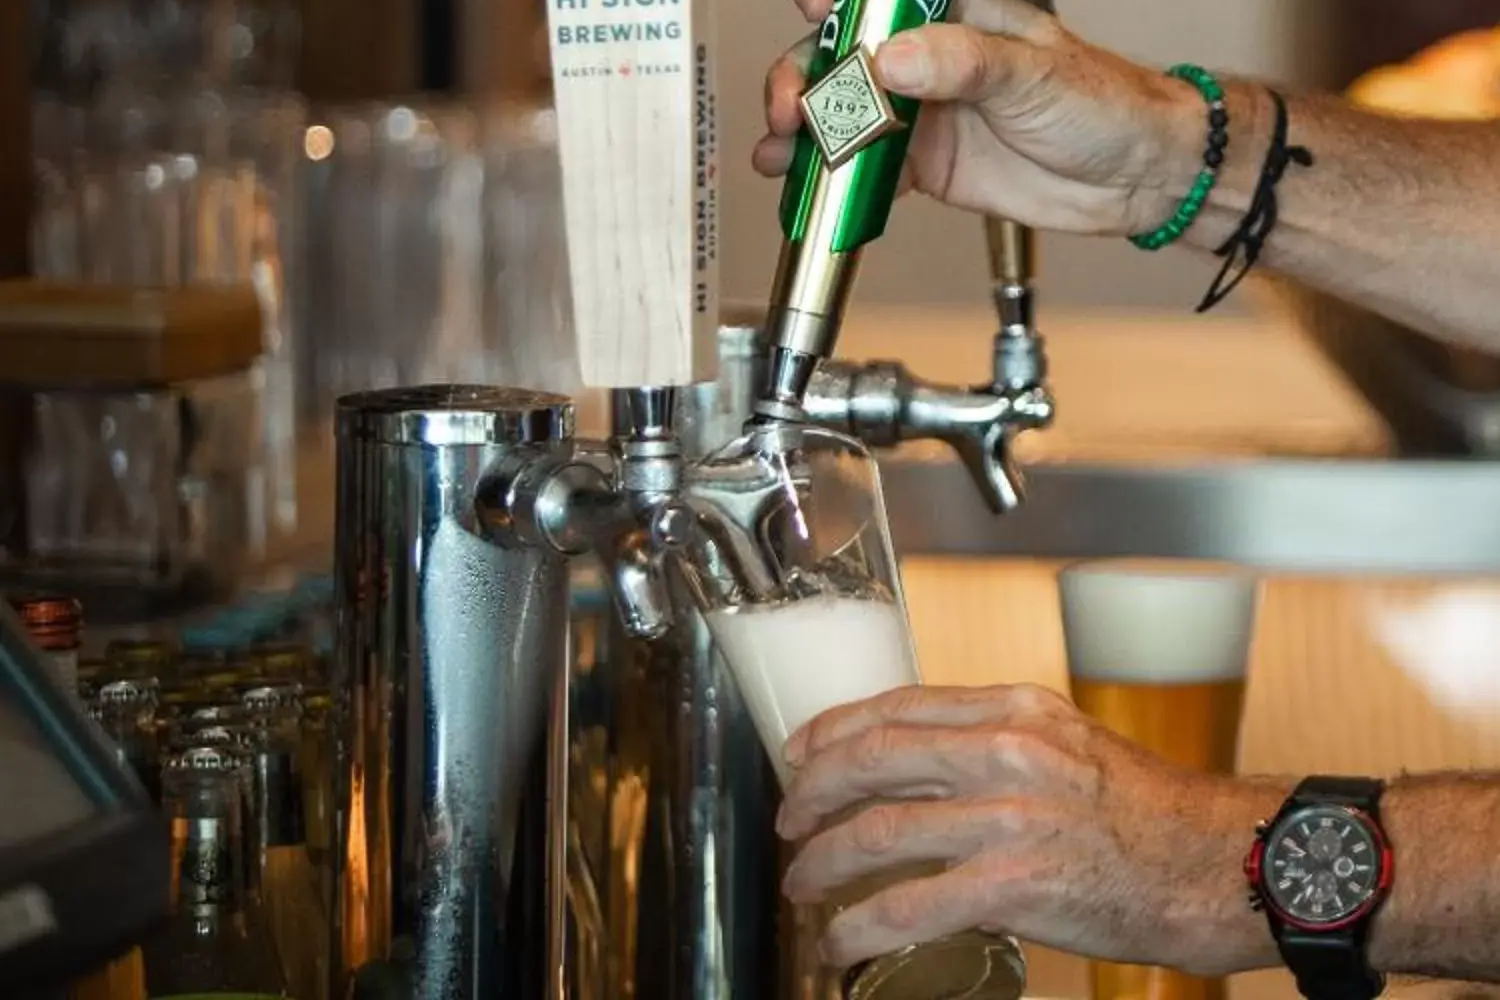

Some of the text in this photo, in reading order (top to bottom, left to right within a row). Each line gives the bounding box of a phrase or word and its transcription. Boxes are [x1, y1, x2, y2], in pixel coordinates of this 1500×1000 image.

[556, 21, 682, 45] BREWING
[561, 63, 682, 78] AUSTIN TEXAS
[695, 43, 706, 188] BREWING
[822, 96, 869, 118] 1897
[696, 282, 706, 313] HI
